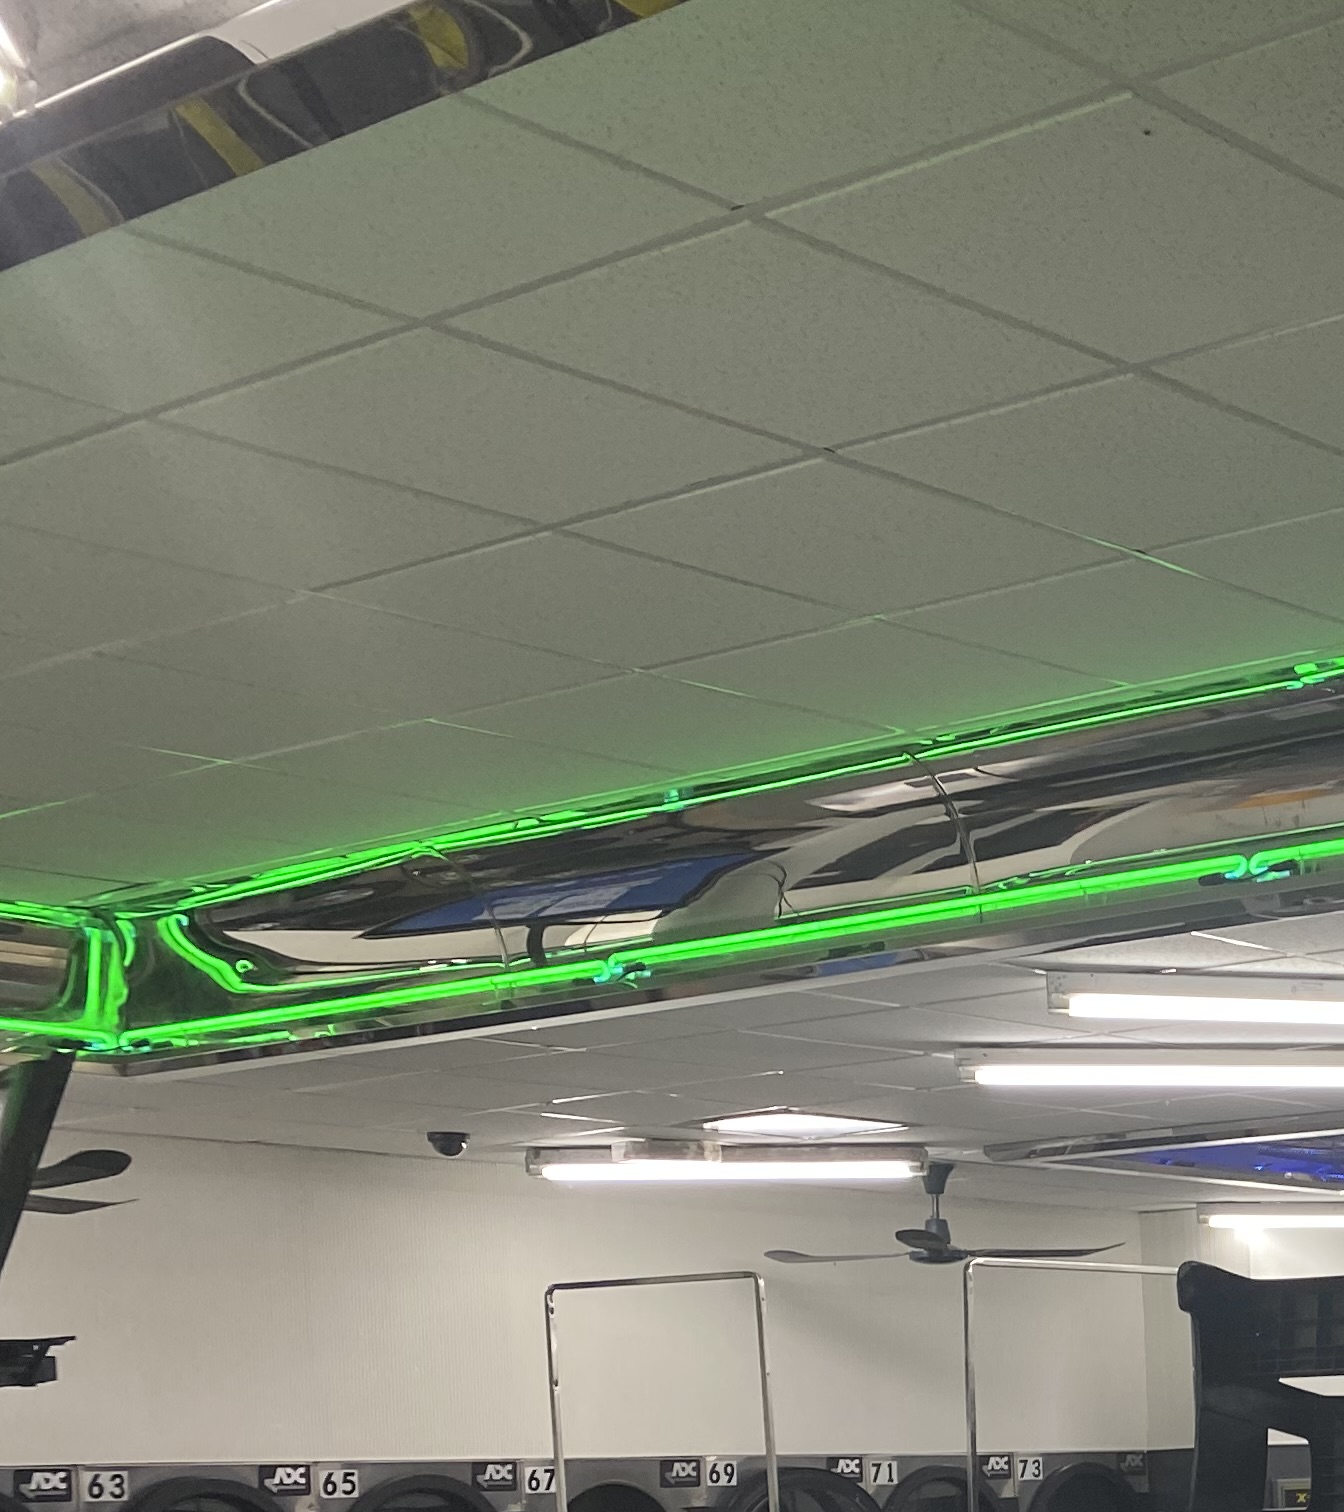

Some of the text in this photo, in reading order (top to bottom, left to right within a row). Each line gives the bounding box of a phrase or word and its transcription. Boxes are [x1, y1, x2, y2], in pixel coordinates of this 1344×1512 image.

[273, 1467, 306, 1485] ADC
[484, 1464, 514, 1481] ADC
[708, 1462, 735, 1484] 69
[871, 1461, 895, 1483] 71
[1018, 1458, 1041, 1479] 73
[29, 1471, 67, 1490] ADC
[87, 1473, 125, 1500] 63
[322, 1471, 357, 1496] 65
[527, 1469, 556, 1492] 67
